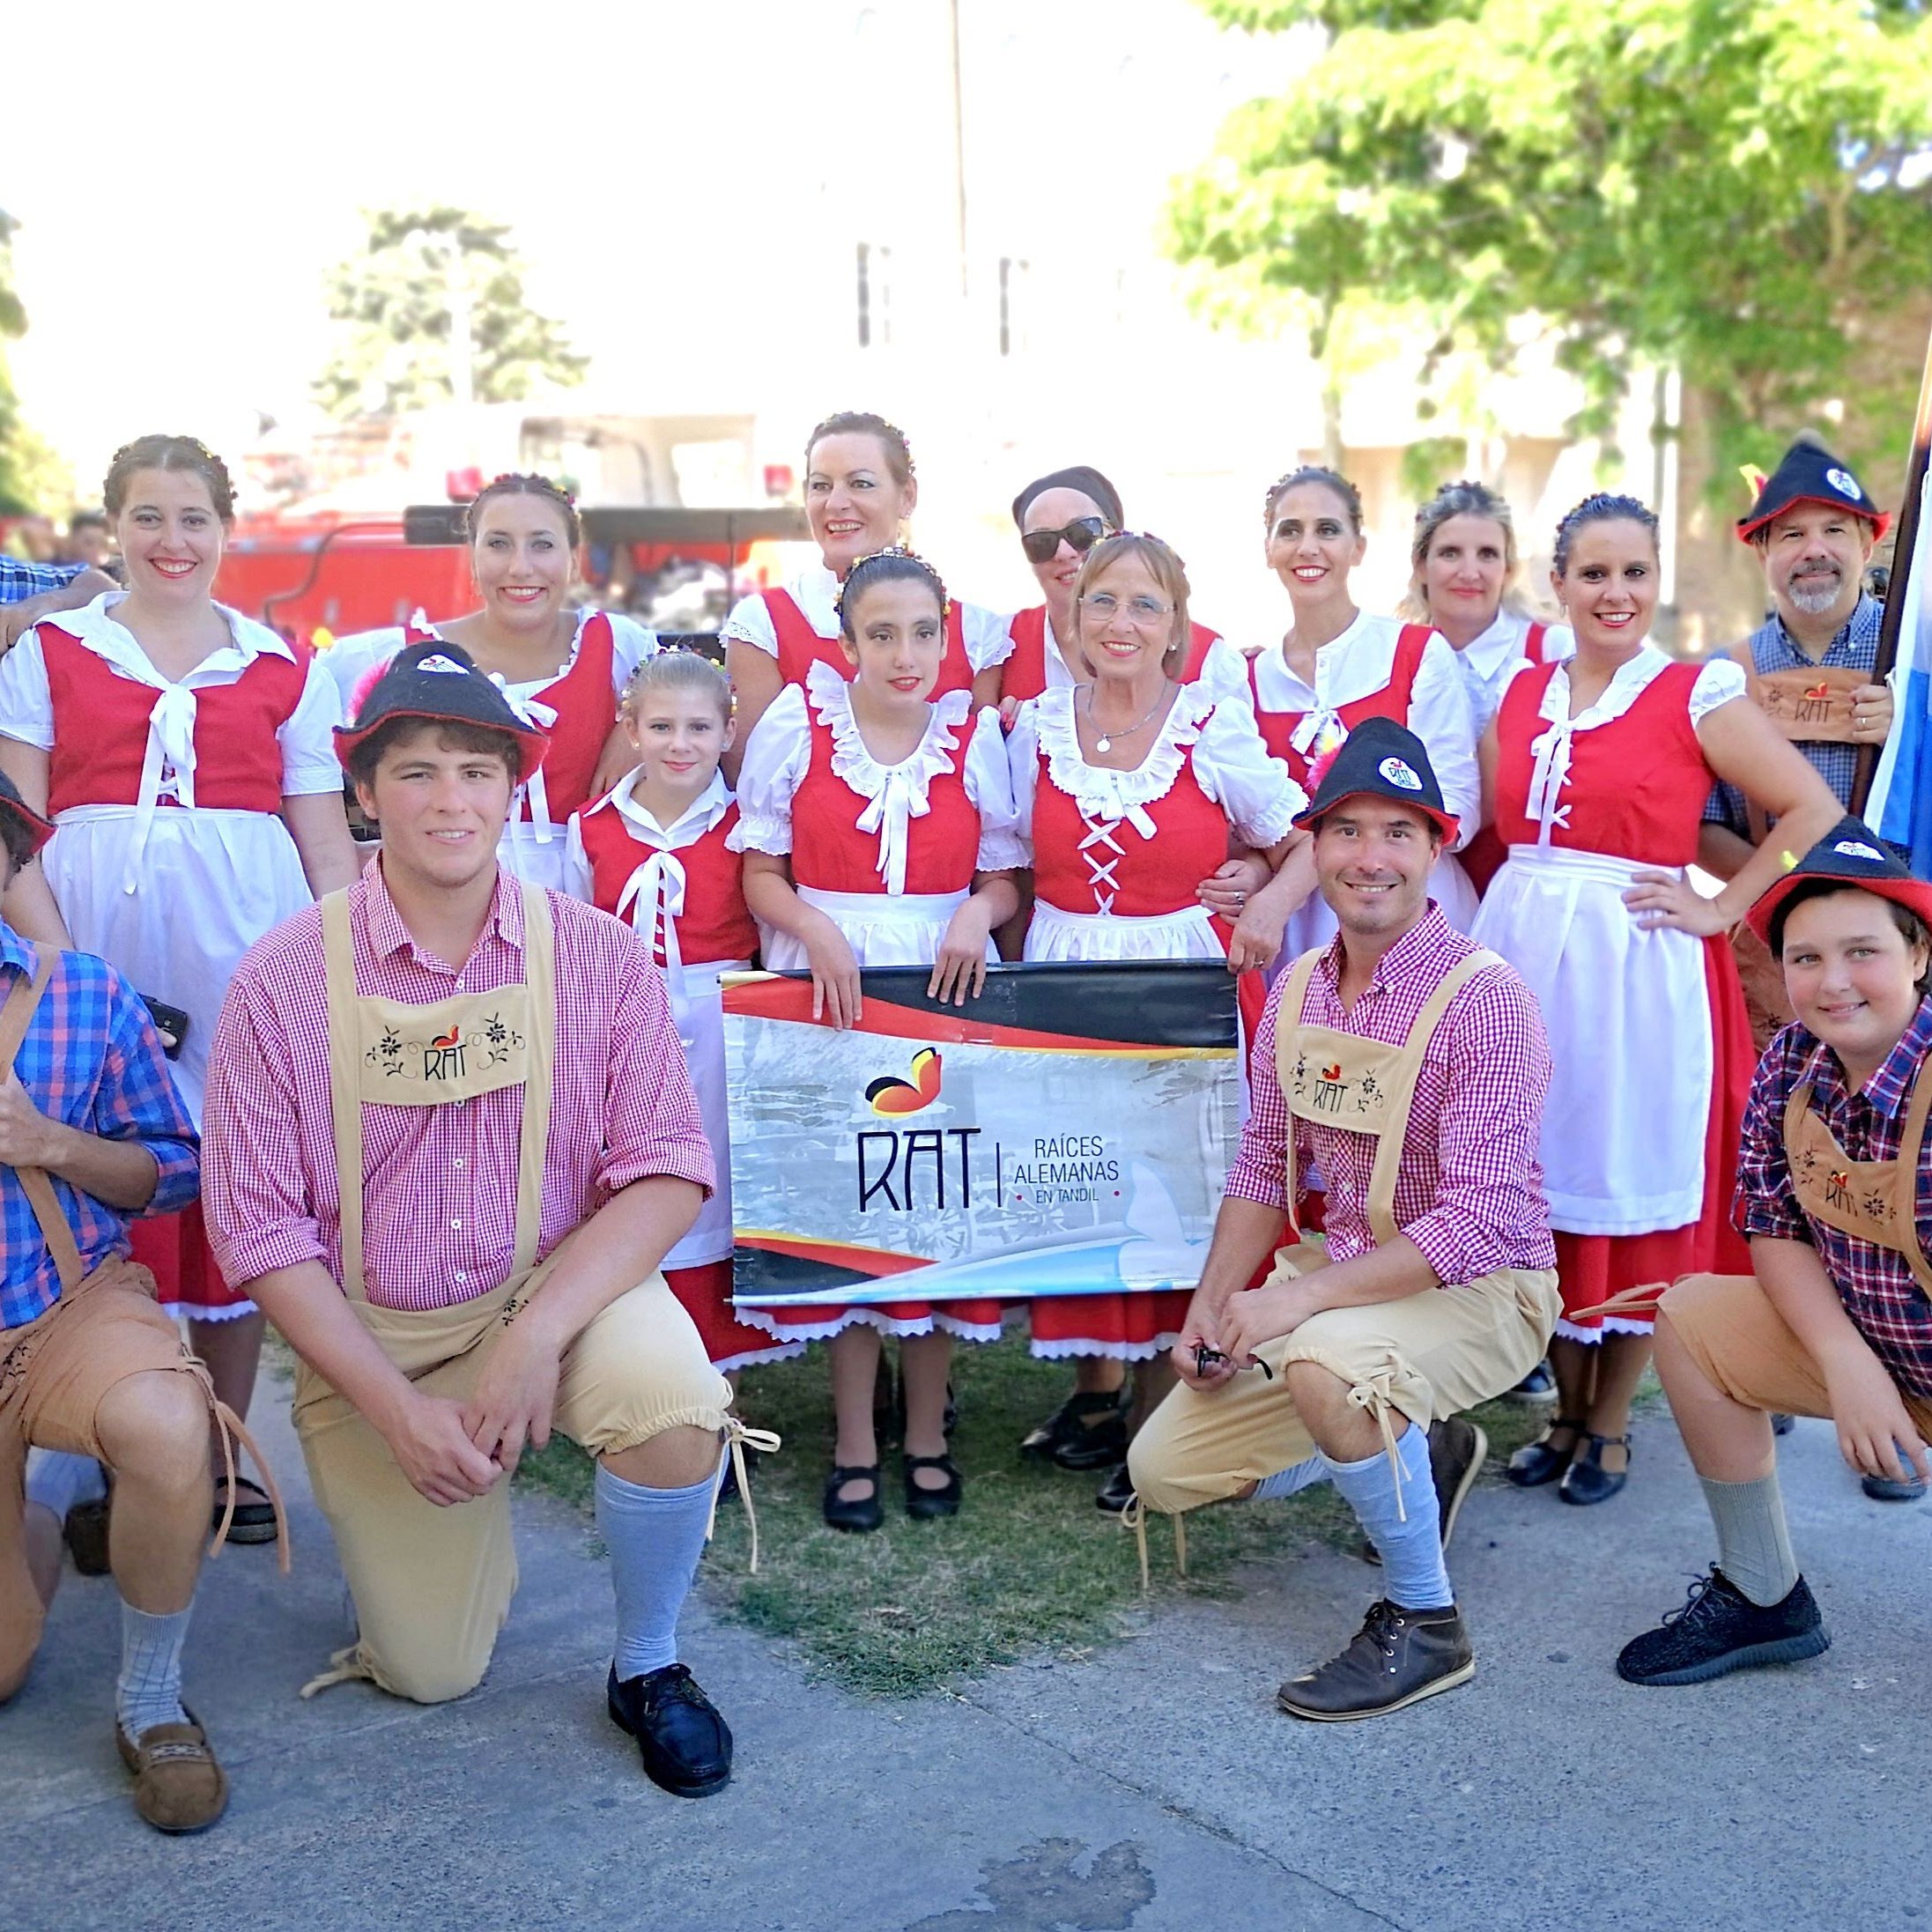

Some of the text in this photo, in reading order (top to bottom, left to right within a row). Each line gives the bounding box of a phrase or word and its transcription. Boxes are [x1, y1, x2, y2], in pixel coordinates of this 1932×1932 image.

[1795, 699, 1833, 722] RAT
[425, 1044, 467, 1081] RAT
[1313, 1079, 1349, 1114] RAT
[1034, 1132, 1103, 1158] RAÍCES
[857, 1128, 981, 1213] RAT
[1014, 1160, 1120, 1184] ALEMANAS
[1036, 1188, 1099, 1203] EN TANDIL
